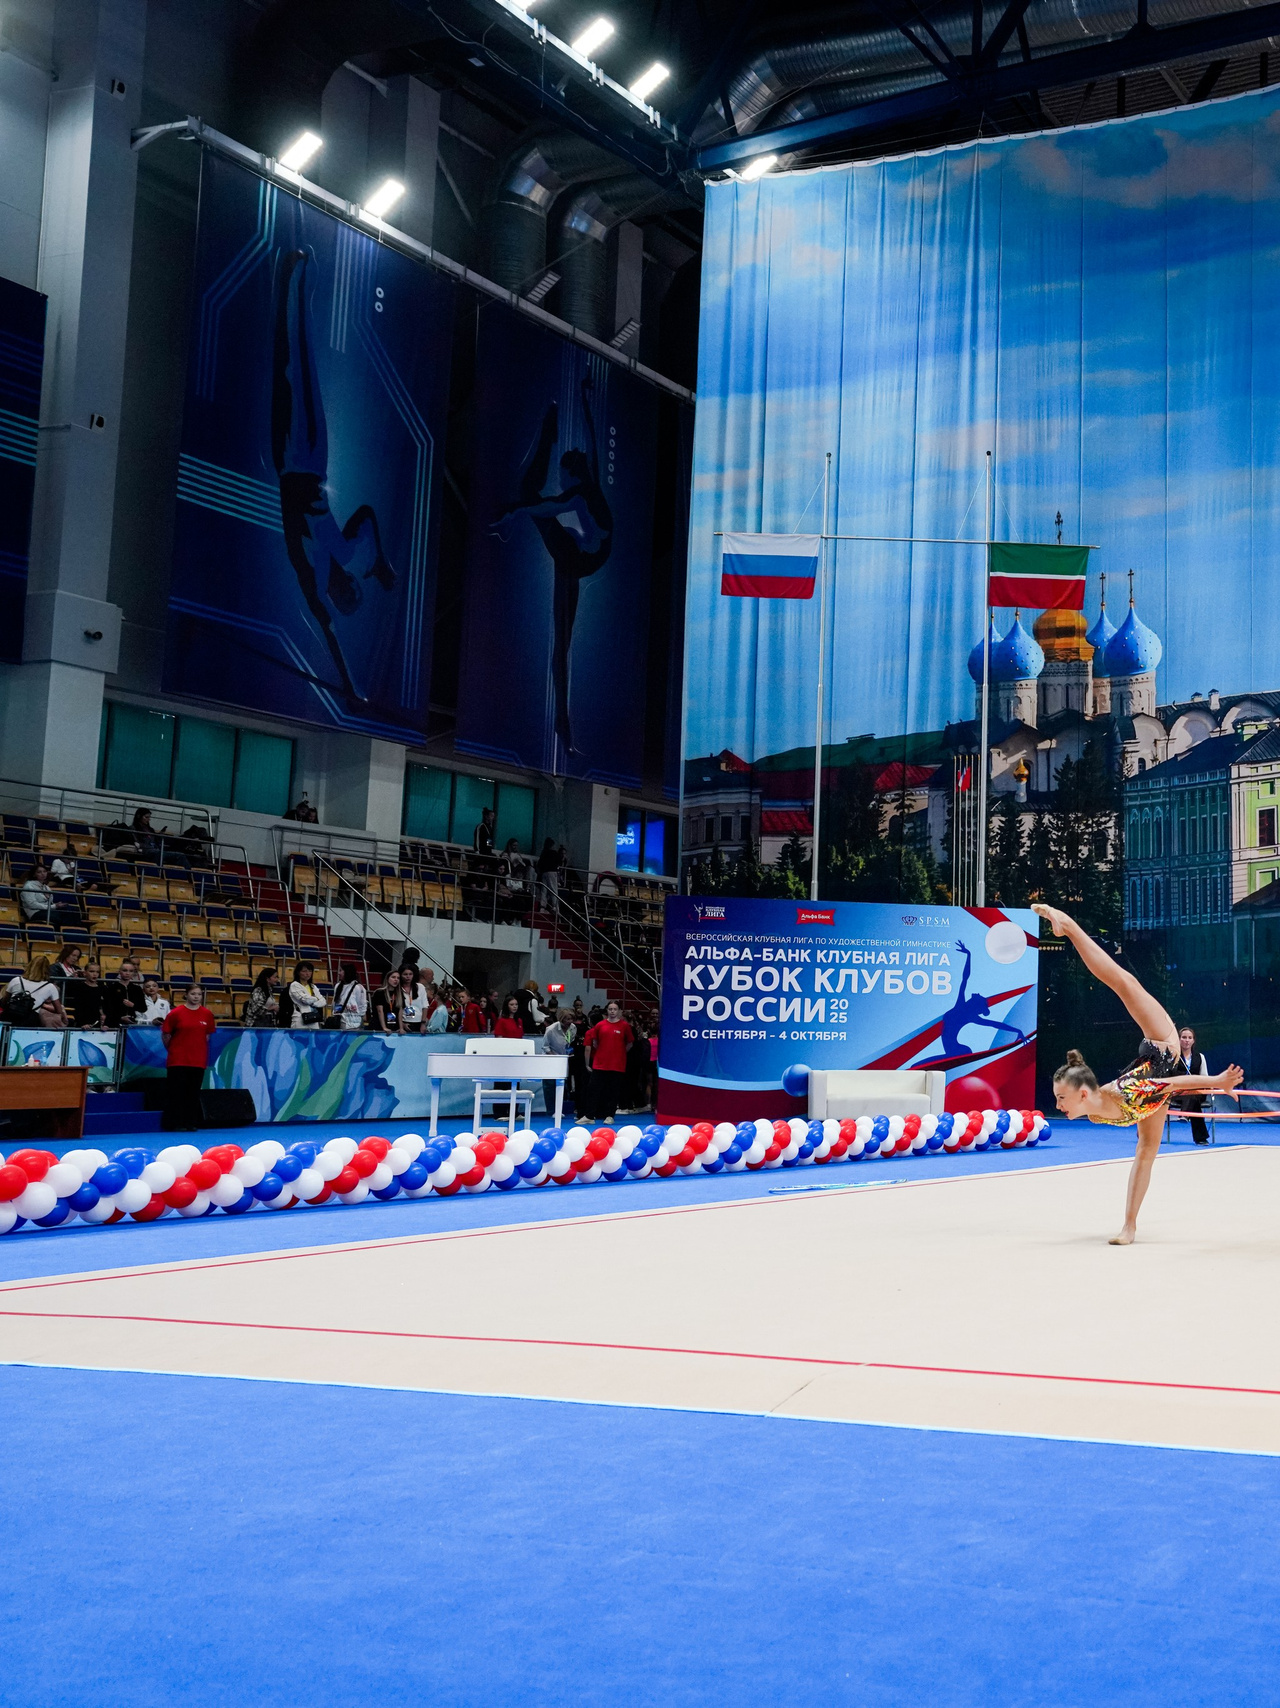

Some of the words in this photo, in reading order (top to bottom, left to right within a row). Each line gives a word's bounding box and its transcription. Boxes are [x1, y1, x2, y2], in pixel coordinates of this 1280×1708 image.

[686, 933, 752, 942] ВСЕРОССИЙСКАЯ
[755, 935, 791, 944] КЛУБНАЯ
[828, 938, 900, 947] ХУДОЖЕСТВЕННОЙ
[902, 940, 951, 948] ГИМНАСТИКЕ
[685, 945, 812, 963] АЛЬФА-БАНК
[816, 949, 900, 965] КЛУБНАЯ
[904, 952, 950, 966] ЛИГА
[683, 964, 804, 992] КУБОК
[814, 968, 952, 995] КЛУБОВ
[682, 994, 826, 1023] РОССИИ
[830, 998, 849, 1010] 20
[829, 1012, 848, 1024] 25
[682, 1029, 698, 1039] 30
[701, 1030, 767, 1040] СЕНТЯБРЯ
[778, 1030, 788, 1040] 4
[790, 1030, 847, 1041] ОКТЯБРЯ
